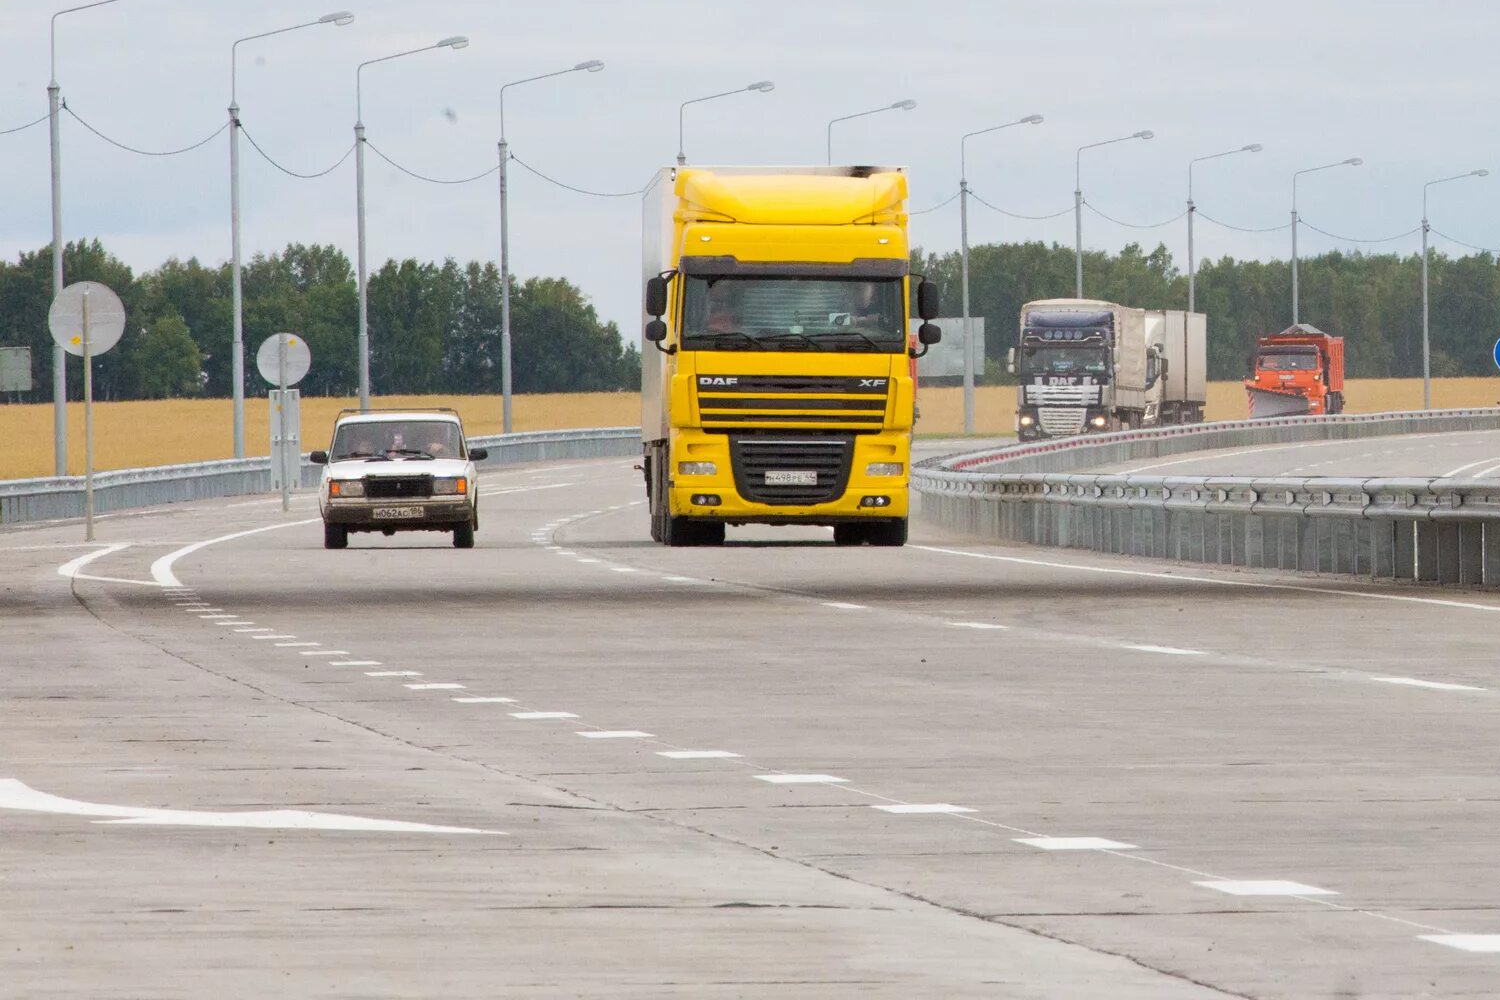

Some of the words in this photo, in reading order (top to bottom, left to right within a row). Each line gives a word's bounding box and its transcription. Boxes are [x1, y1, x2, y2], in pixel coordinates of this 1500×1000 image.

[699, 377, 738, 386] DAF
[858, 379, 887, 387] XF
[1048, 376, 1077, 386] DAF
